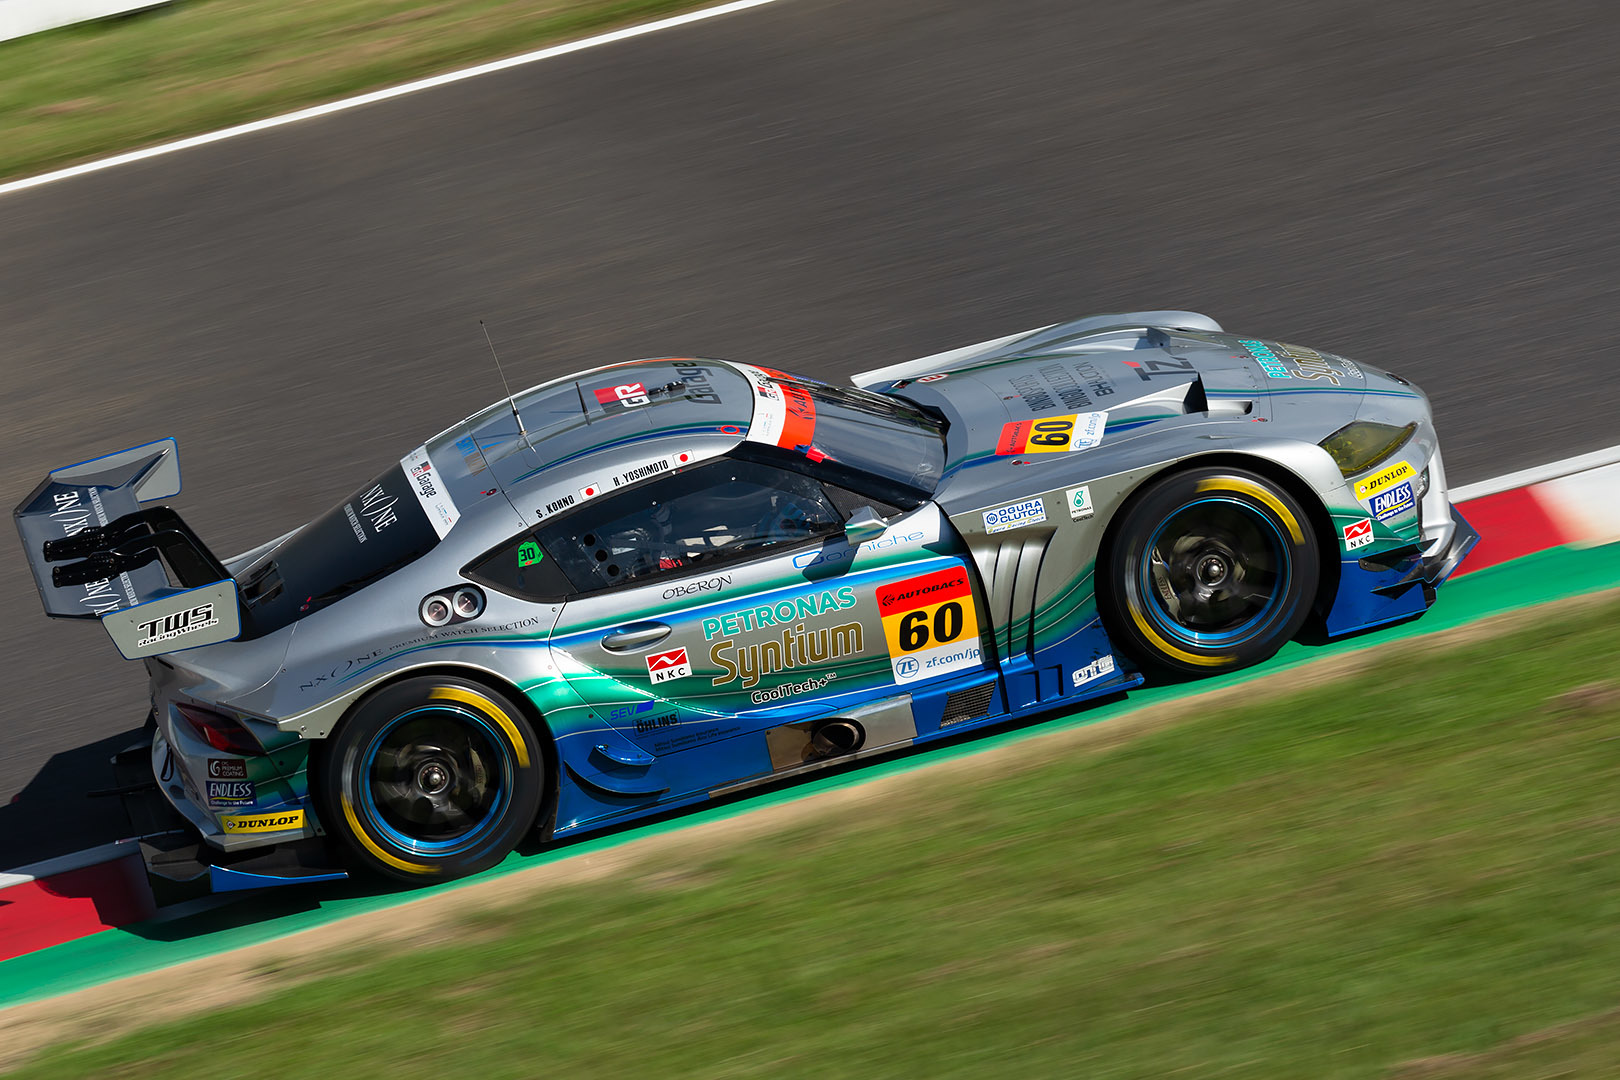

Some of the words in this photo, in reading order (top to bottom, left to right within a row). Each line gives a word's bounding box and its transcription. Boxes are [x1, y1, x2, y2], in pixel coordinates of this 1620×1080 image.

[614, 382, 650, 408] GR
[1030, 421, 1073, 446] 60
[416, 470, 437, 498] Garage
[1370, 466, 1407, 490] DUNLOP
[999, 501, 1041, 516] OGURA
[1375, 484, 1411, 513] ENDLESS
[1000, 507, 1043, 523] CLUTCH
[792, 531, 924, 569] Corniche
[1350, 534, 1371, 549] NKC
[519, 548, 535, 562] 30
[662, 574, 733, 600] OBERON
[896, 578, 964, 601] AUTOBACS
[137, 602, 214, 638] TWS
[701, 586, 857, 642] PETRONAS
[899, 602, 963, 651] 60
[389, 634, 437, 651] PREMIUM
[441, 627, 479, 638] WATCH
[481, 616, 539, 633] SELECTION
[708, 620, 865, 688] Syntium
[897, 658, 918, 677] ZF
[925, 648, 980, 668] zf.com/jp
[656, 666, 686, 682] NKC
[610, 703, 636, 721] SEV
[636, 713, 679, 734] ÖHLINS
[209, 782, 252, 797] ENDLESS
[237, 815, 299, 829] DUNLOP
